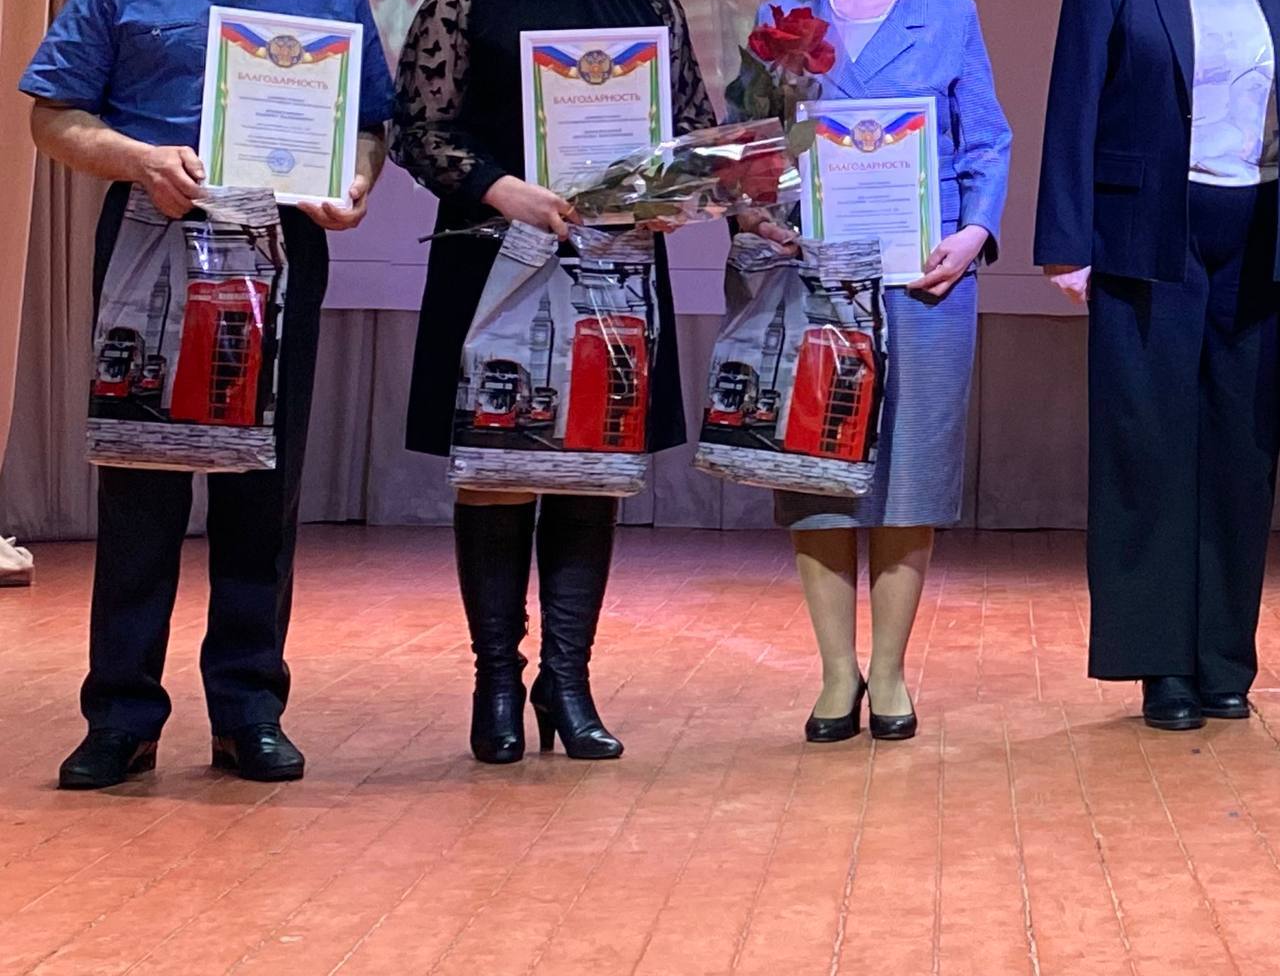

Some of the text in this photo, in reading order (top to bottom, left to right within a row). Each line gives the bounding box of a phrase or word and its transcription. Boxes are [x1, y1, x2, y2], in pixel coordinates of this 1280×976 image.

[237, 71, 329, 90] БЛАГОДАРНОСТЬ
[553, 92, 641, 105] БЛАГОДАРНОСТЬ
[828, 160, 911, 173] БЛАГОДАРНОСТЬ
